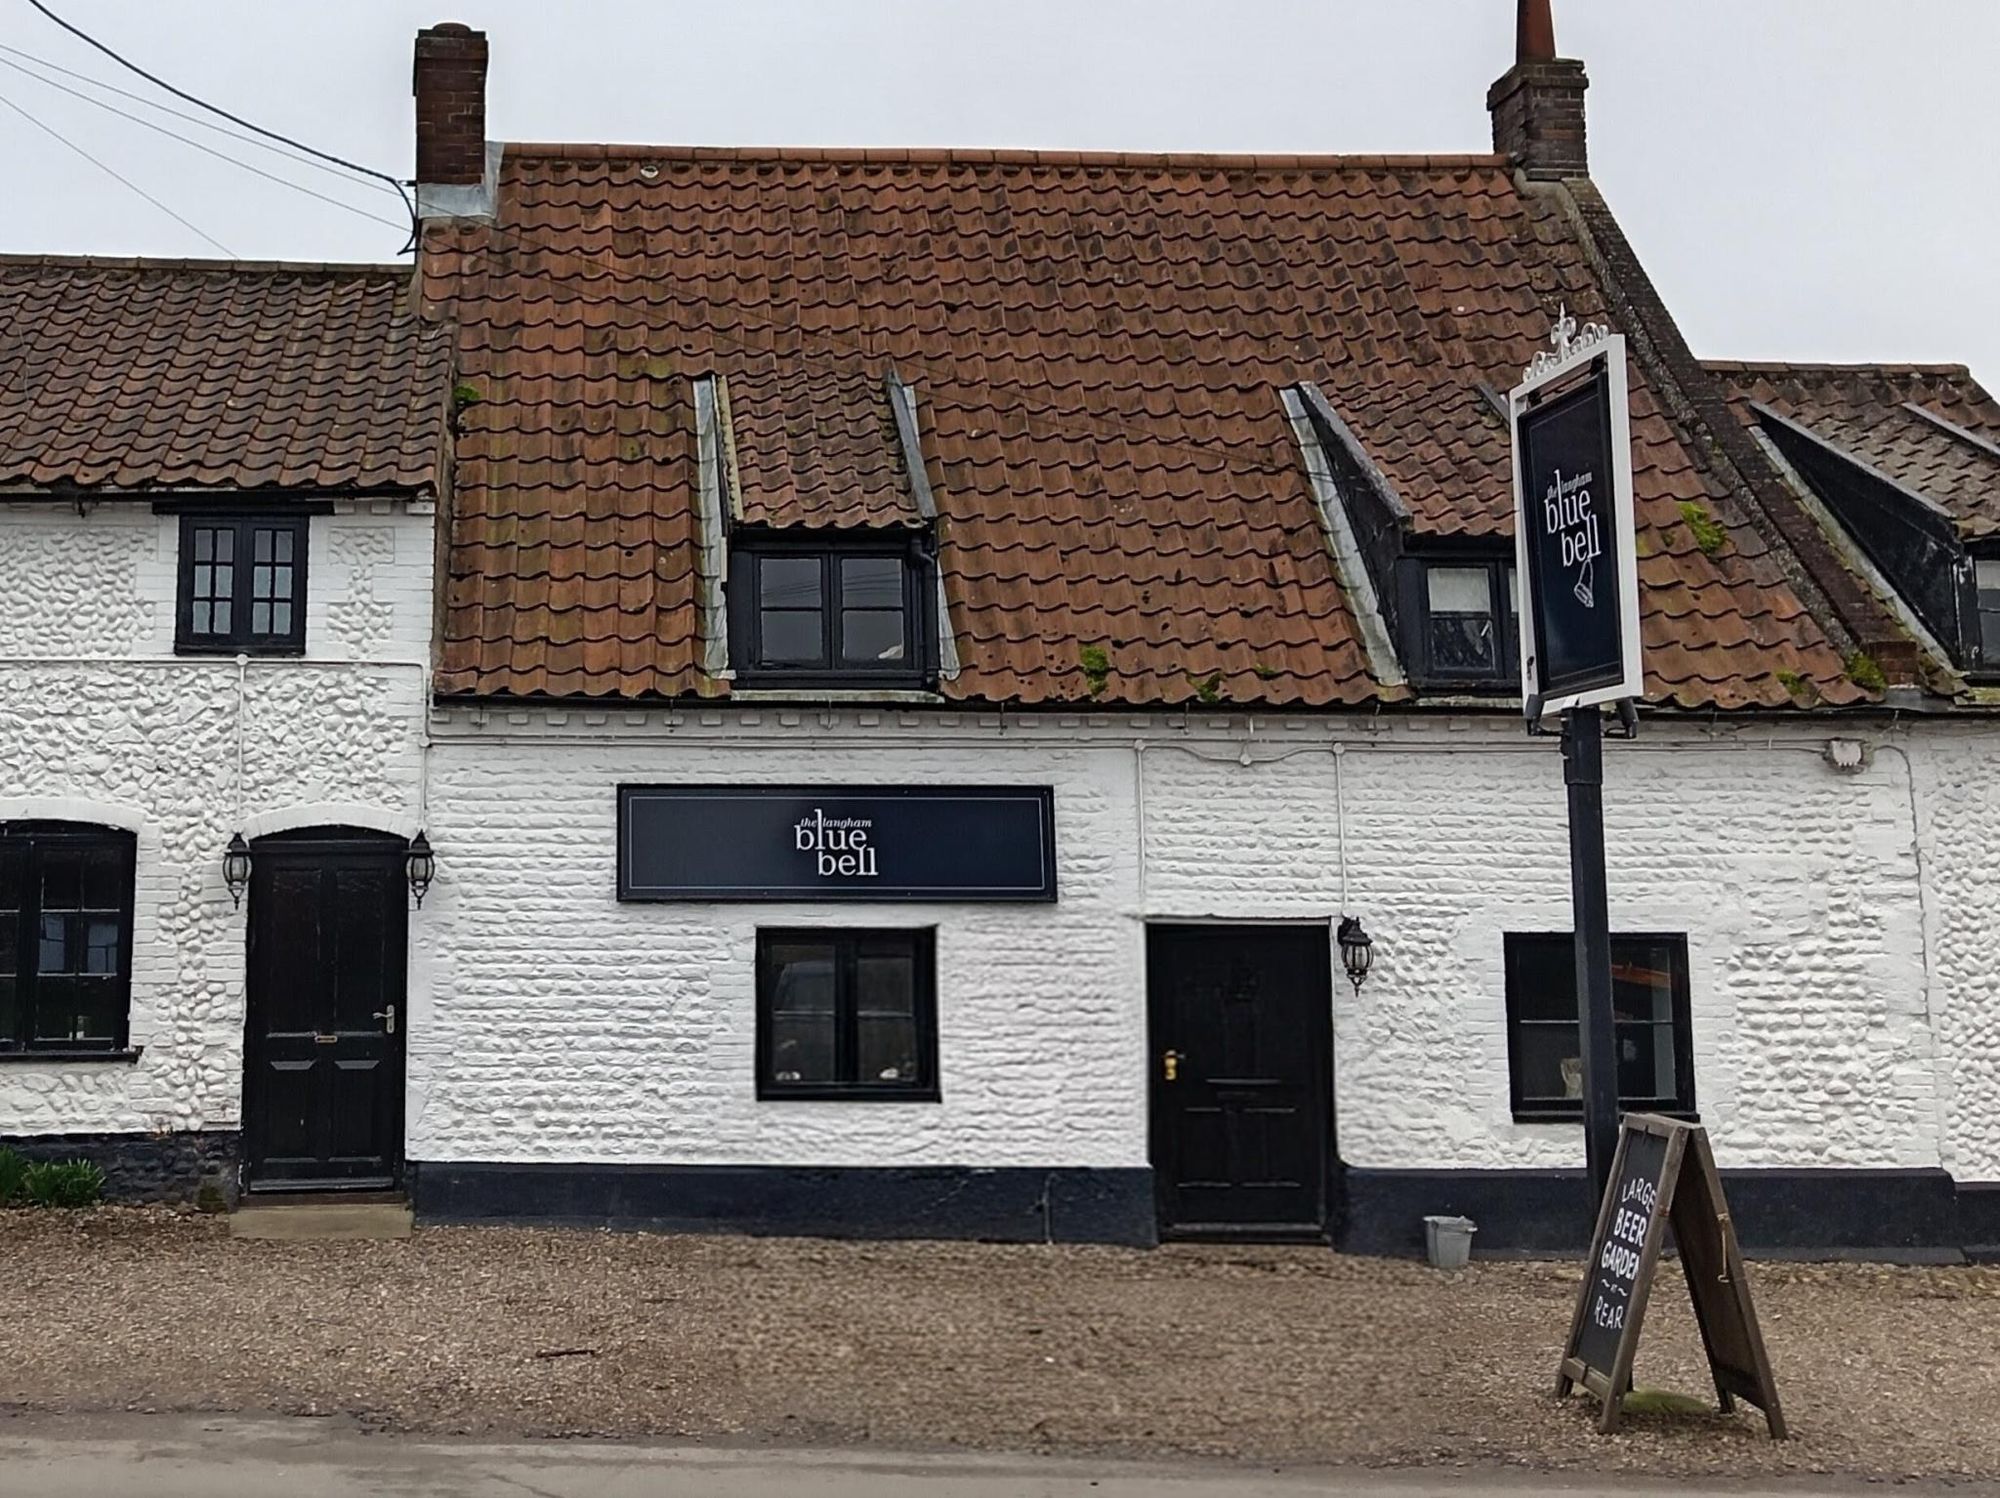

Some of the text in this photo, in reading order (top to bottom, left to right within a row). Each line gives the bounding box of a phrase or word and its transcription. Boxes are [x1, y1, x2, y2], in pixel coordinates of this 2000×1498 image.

[1544, 469, 1591, 534] blue
[1561, 513, 1602, 567] bell
[794, 808, 867, 850] blue
[800, 817, 872, 829] the langham
[818, 847, 879, 876] bell
[1622, 1177, 1657, 1214] LARGE
[1613, 1207, 1647, 1247] BEER
[1594, 1296, 1624, 1330] REAR
